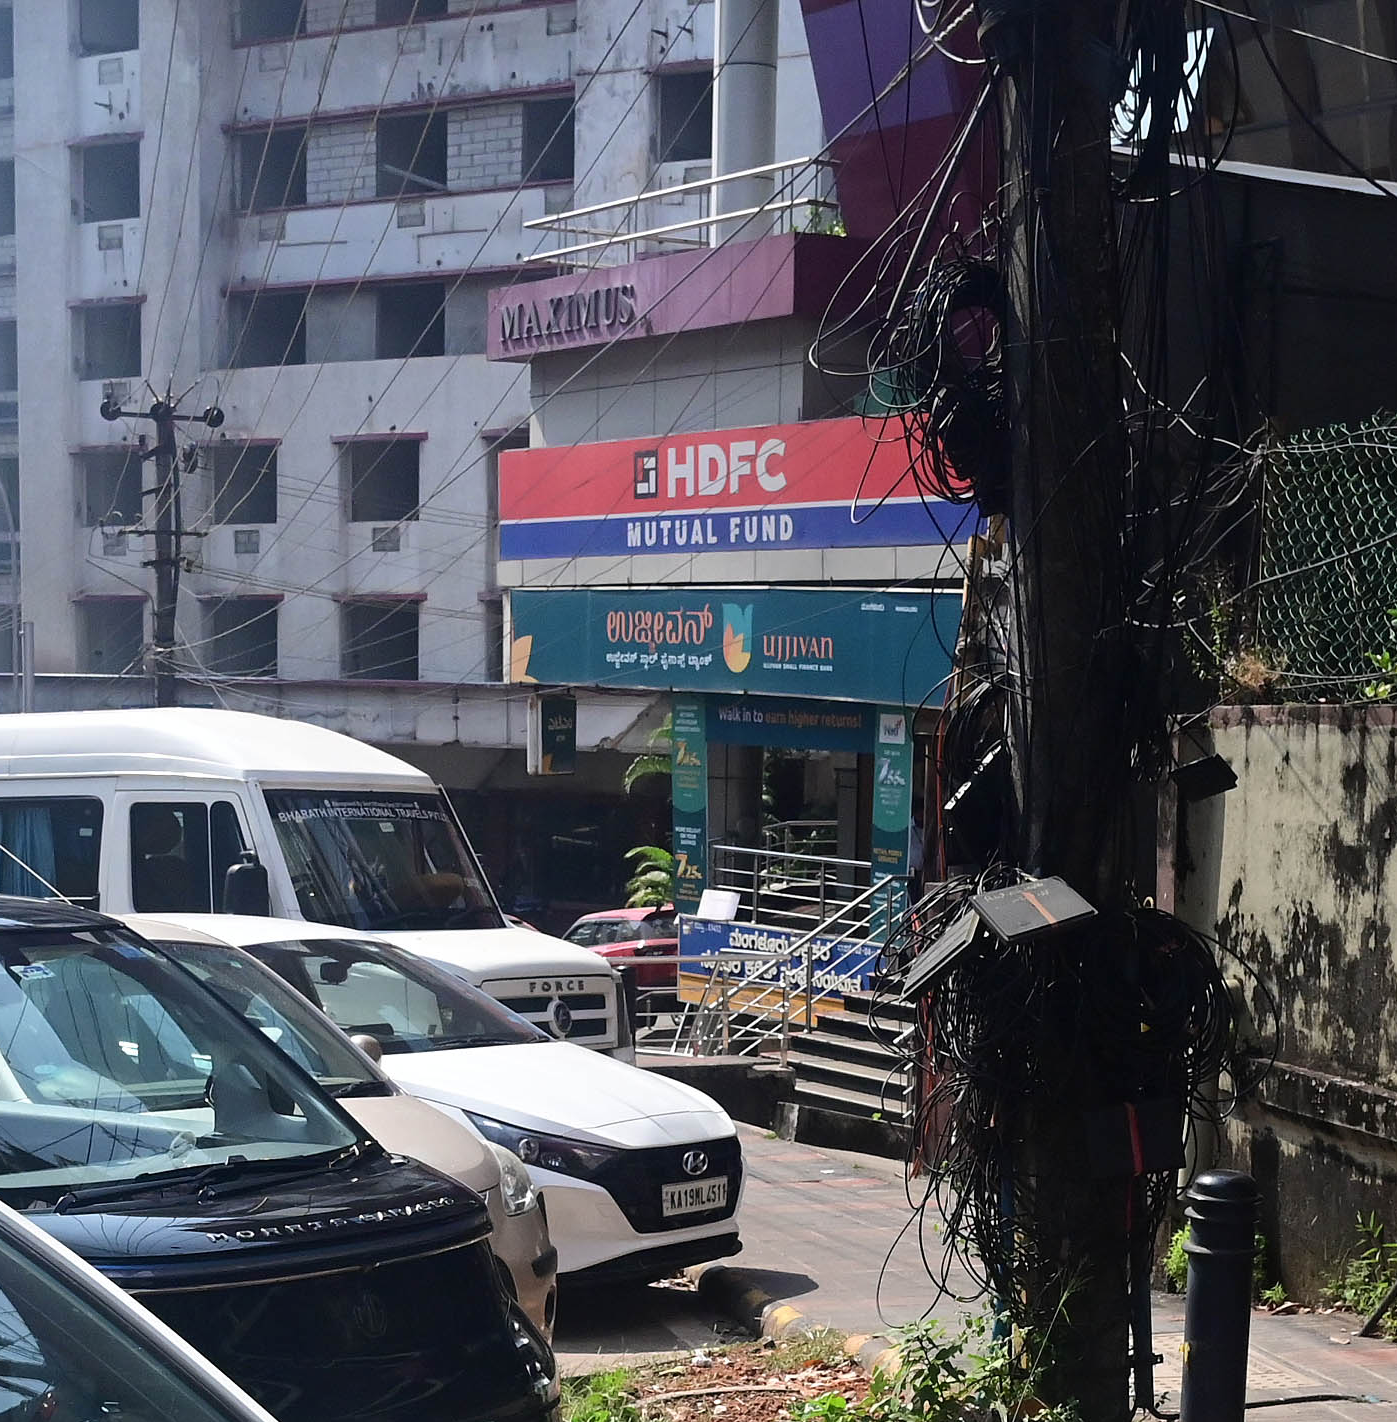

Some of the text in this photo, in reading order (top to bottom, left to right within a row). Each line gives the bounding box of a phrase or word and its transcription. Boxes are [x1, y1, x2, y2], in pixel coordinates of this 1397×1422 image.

[499, 283, 636, 344] MAXIMUS
[666, 438, 787, 498] HDFC
[626, 514, 794, 548] MUTUAL FUND
[719, 706, 741, 722] Walk
[743, 706, 752, 723] in
[753, 709, 764, 724] to
[788, 709, 820, 729] higher
[278, 807, 327, 823] BHARATH
[328, 806, 396, 818] INTERNATIONAL
[396, 808, 428, 820] TRAVELS
[529, 980, 584, 992] FORCE
